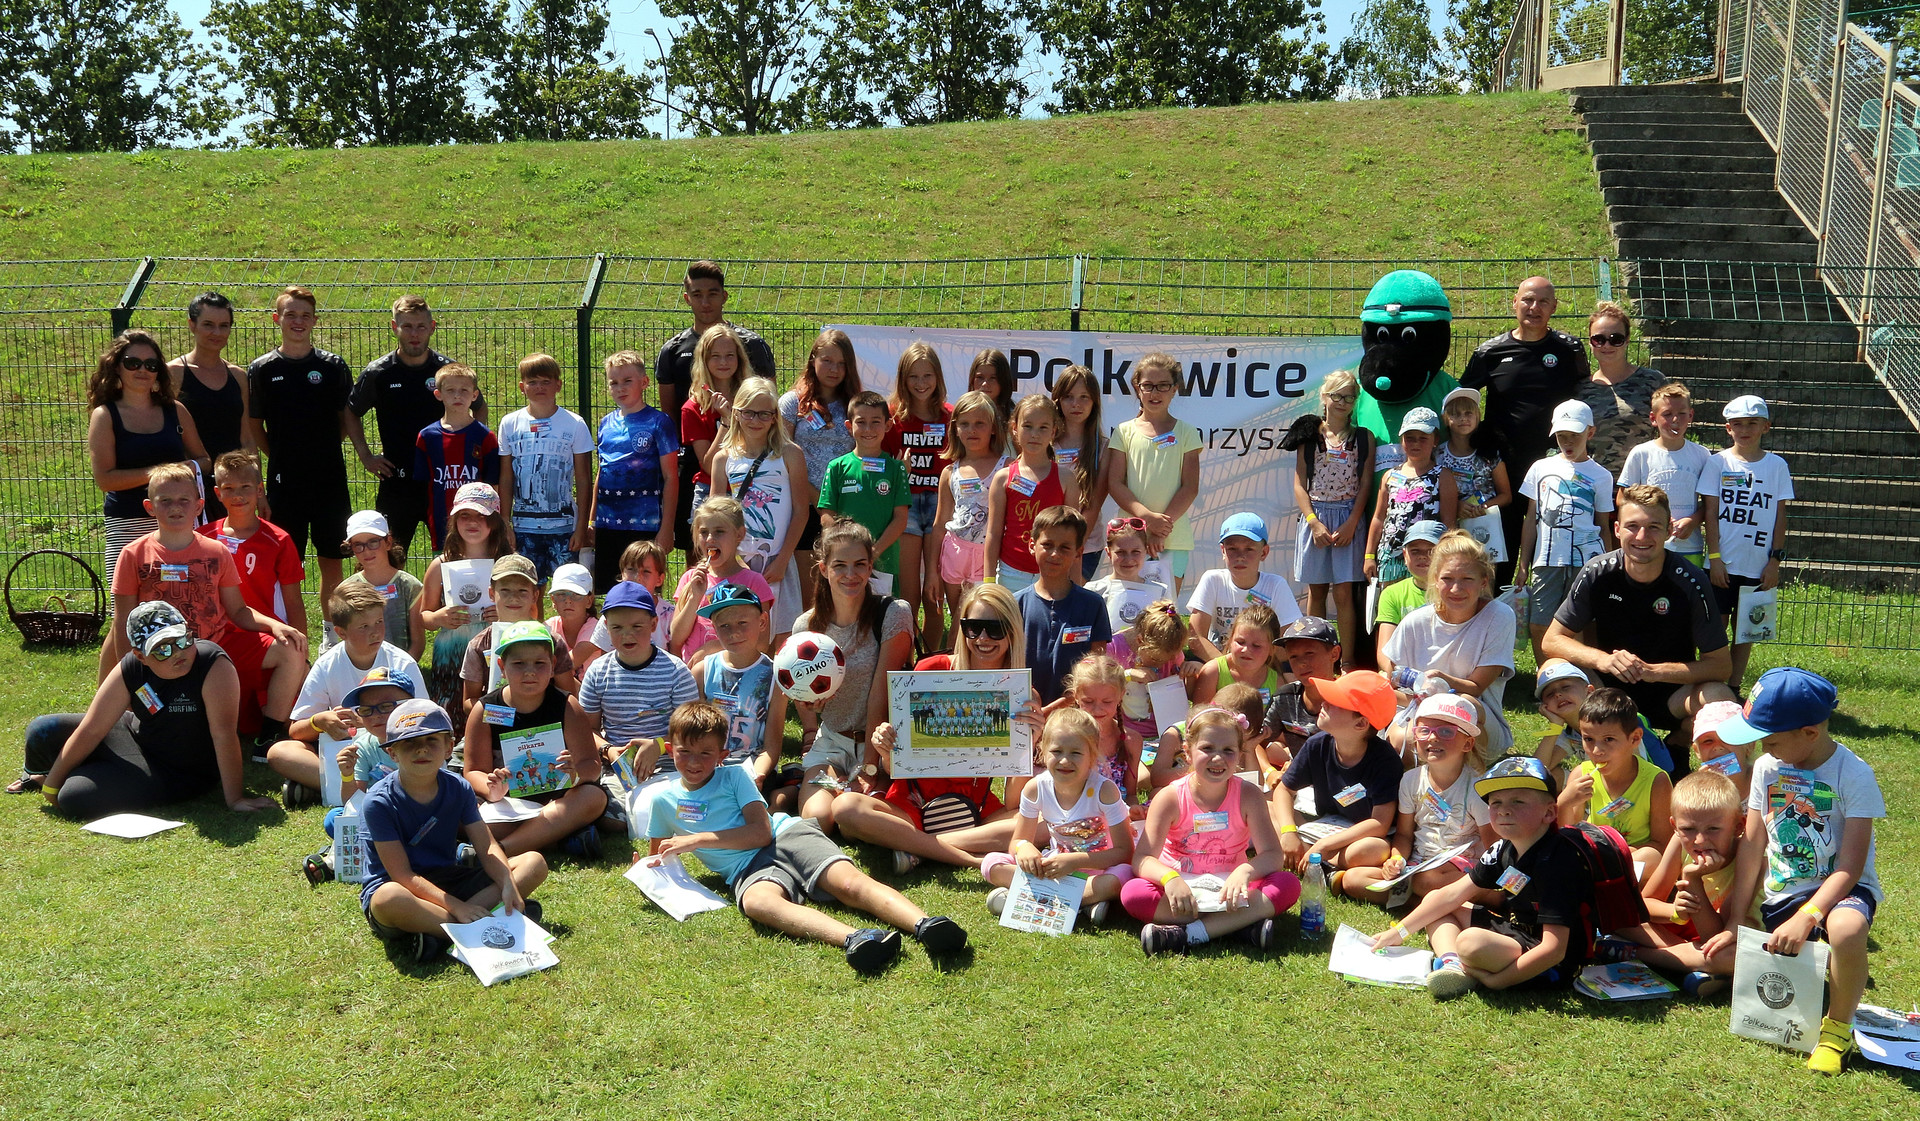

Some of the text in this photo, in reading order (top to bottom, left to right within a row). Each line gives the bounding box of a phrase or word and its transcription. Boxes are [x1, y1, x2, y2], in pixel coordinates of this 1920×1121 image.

[1009, 347, 1307, 398] Polkwice
[636, 437, 648, 447] 96
[903, 433, 943, 447] NEVER
[910, 455, 933, 468] SAY
[275, 473, 281, 484] 4
[907, 475, 939, 487] EVER
[1721, 488, 1773, 509] BEAT
[1718, 506, 1759, 526] ABL
[245, 552, 257, 575] 9
[713, 584, 737, 604] NY
[1609, 593, 1623, 602] JAKO
[805, 660, 827, 675] JAKO
[168, 704, 198, 713] SURFING
[1742, 1014, 1784, 1032] Polkowice
